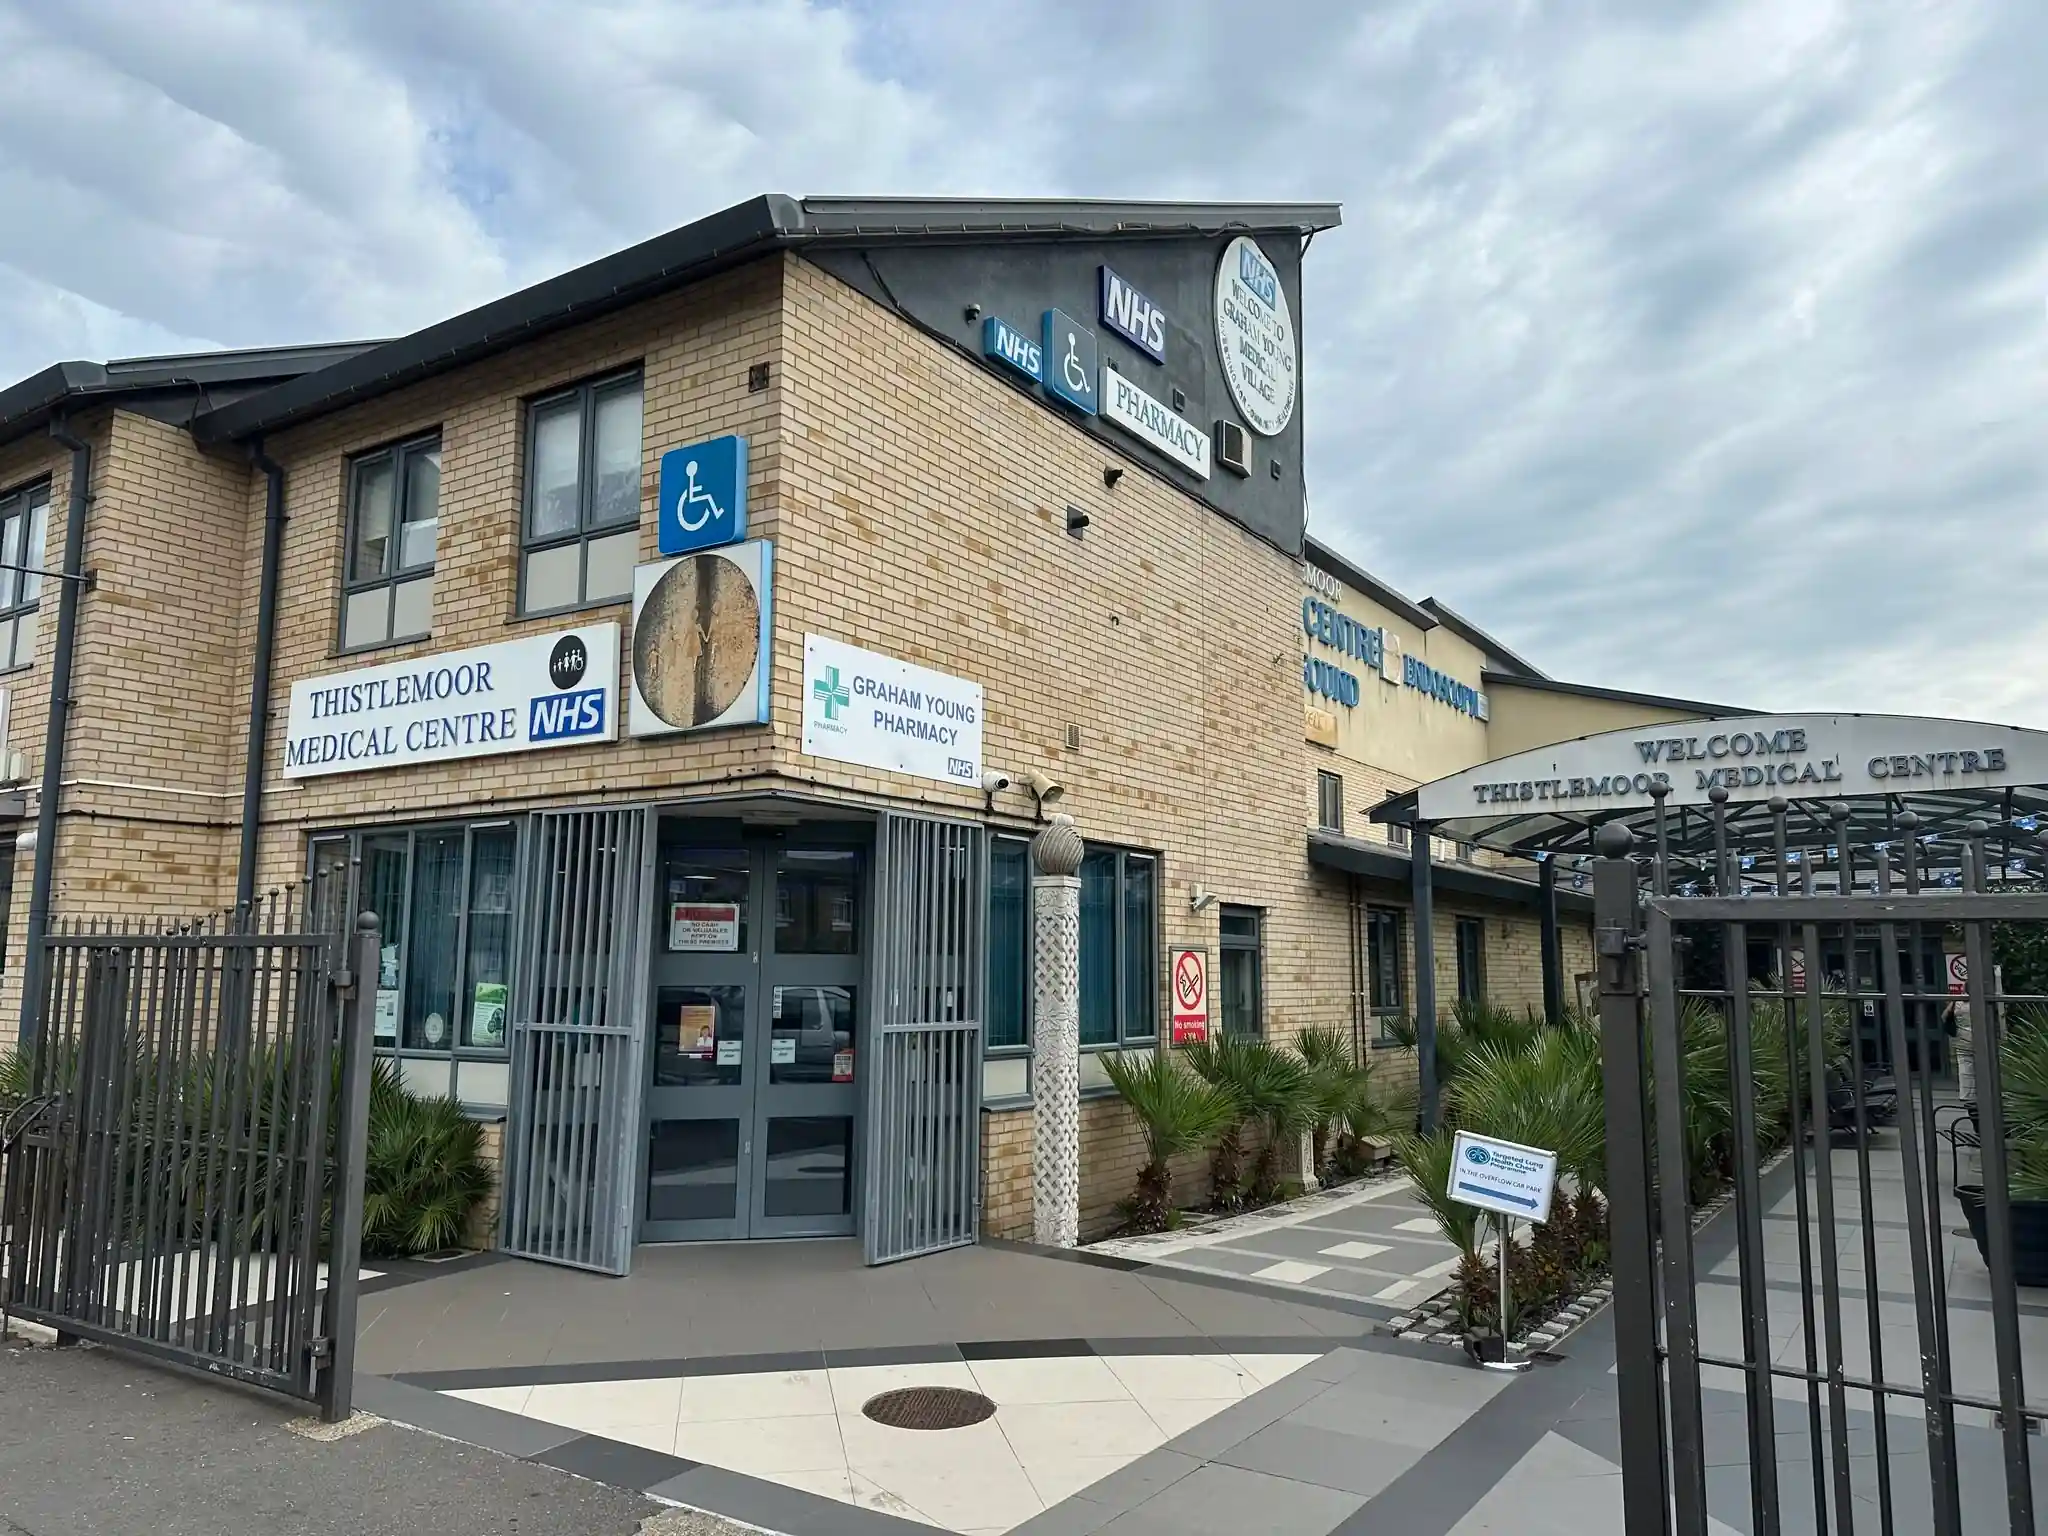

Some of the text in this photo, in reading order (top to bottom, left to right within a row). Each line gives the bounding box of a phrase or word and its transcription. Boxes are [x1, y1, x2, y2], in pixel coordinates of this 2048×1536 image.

[1242, 250, 1275, 305] NHS
[1107, 275, 1166, 353] NHS
[1231, 279, 1271, 331] WELCOME
[996, 325, 1042, 375] NHS
[1223, 298, 1293, 373] GRAHAM YOUNG
[1116, 380, 1204, 462] PHARMACY
[1302, 596, 1381, 669] CENTRE
[310, 662, 494, 719] THISTLEMOOR
[531, 692, 602, 737] NHS
[853, 675, 975, 724] GRAHAM YOUNG
[286, 708, 517, 768] MEDICAL CENTRE
[813, 720, 848, 735] PHARMACY
[874, 710, 958, 746] PHARMACY
[1634, 728, 1808, 765] WELCOME
[949, 758, 973, 778] NHS
[1695, 758, 1842, 790] MEDICAL
[1869, 748, 2007, 780] CENTRE
[1175, 1019, 1204, 1031] No smoking
[1491, 1156, 1537, 1172] Health Check
[1492, 1151, 1544, 1169] Targeted Lung
